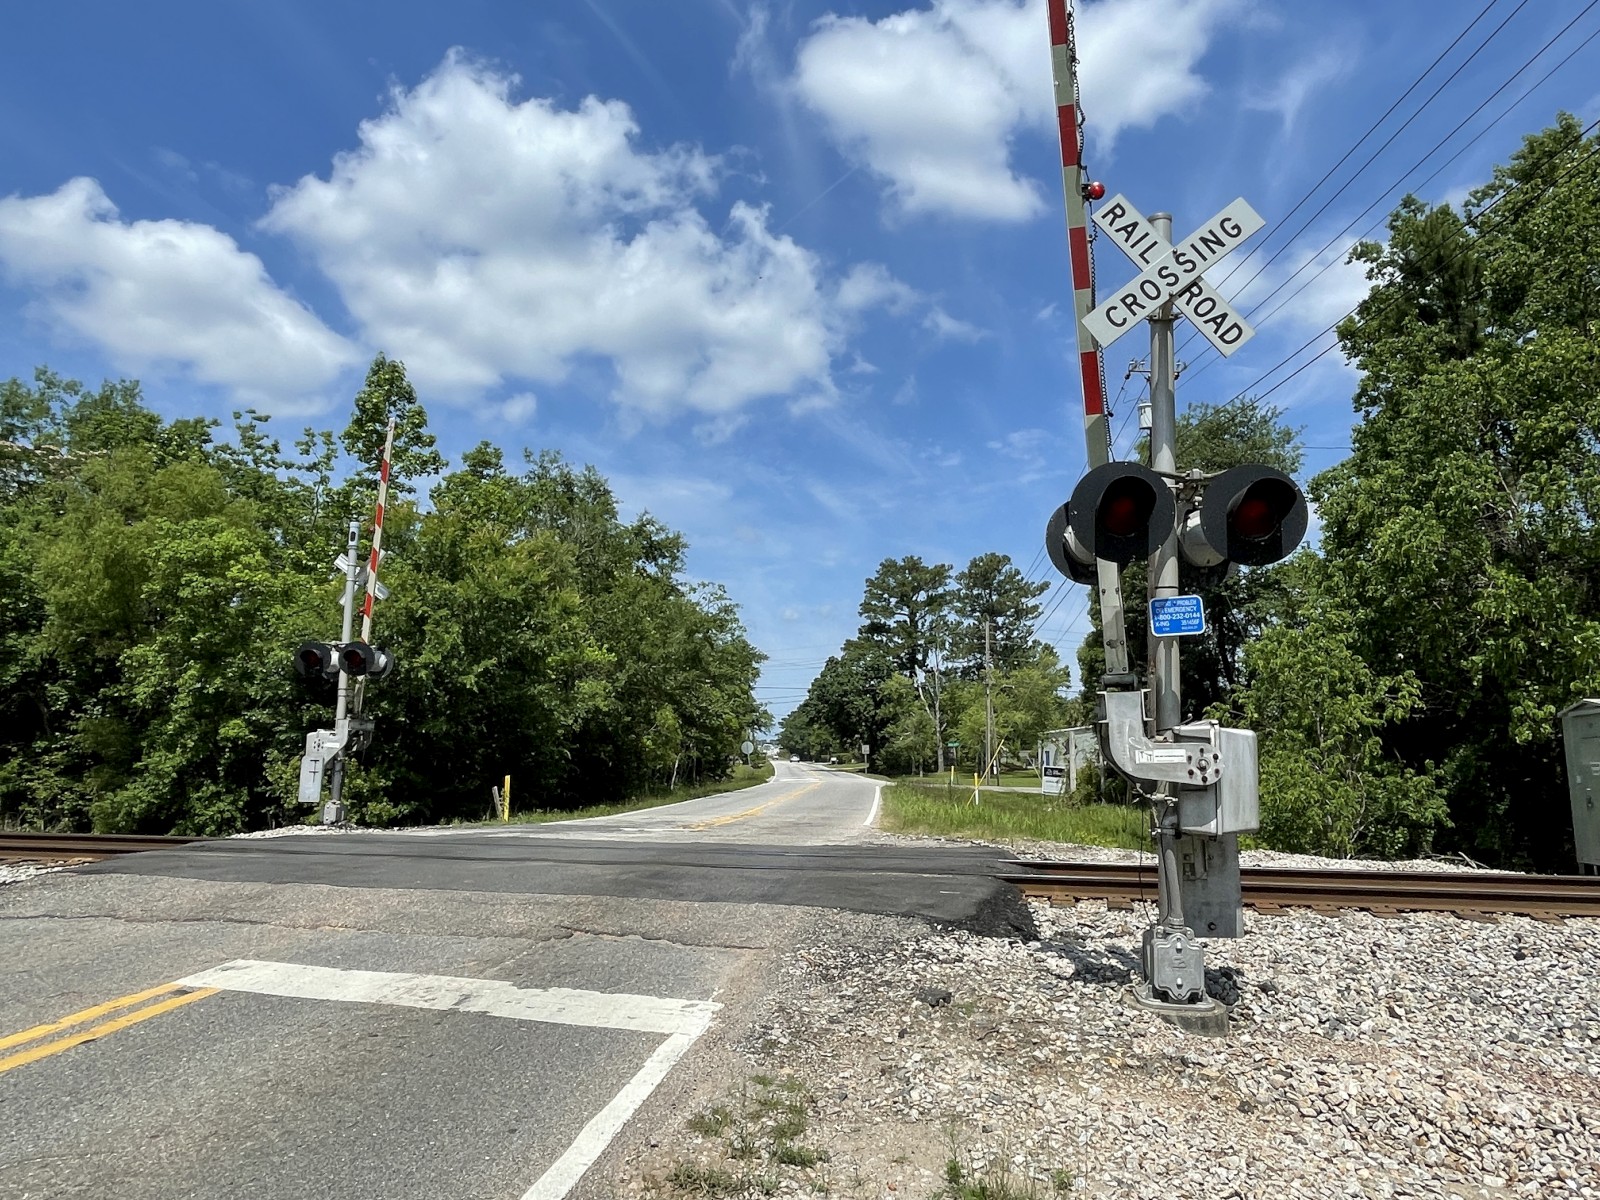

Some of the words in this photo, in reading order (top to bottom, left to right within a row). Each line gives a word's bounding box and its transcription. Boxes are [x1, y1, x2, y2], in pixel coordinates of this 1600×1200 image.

[1101, 202, 1158, 264] RAIL
[1178, 281, 1243, 345] ROAD
[1105, 217, 1242, 328] CROSSING
[1154, 612, 1200, 620] 1-800-232-0144
